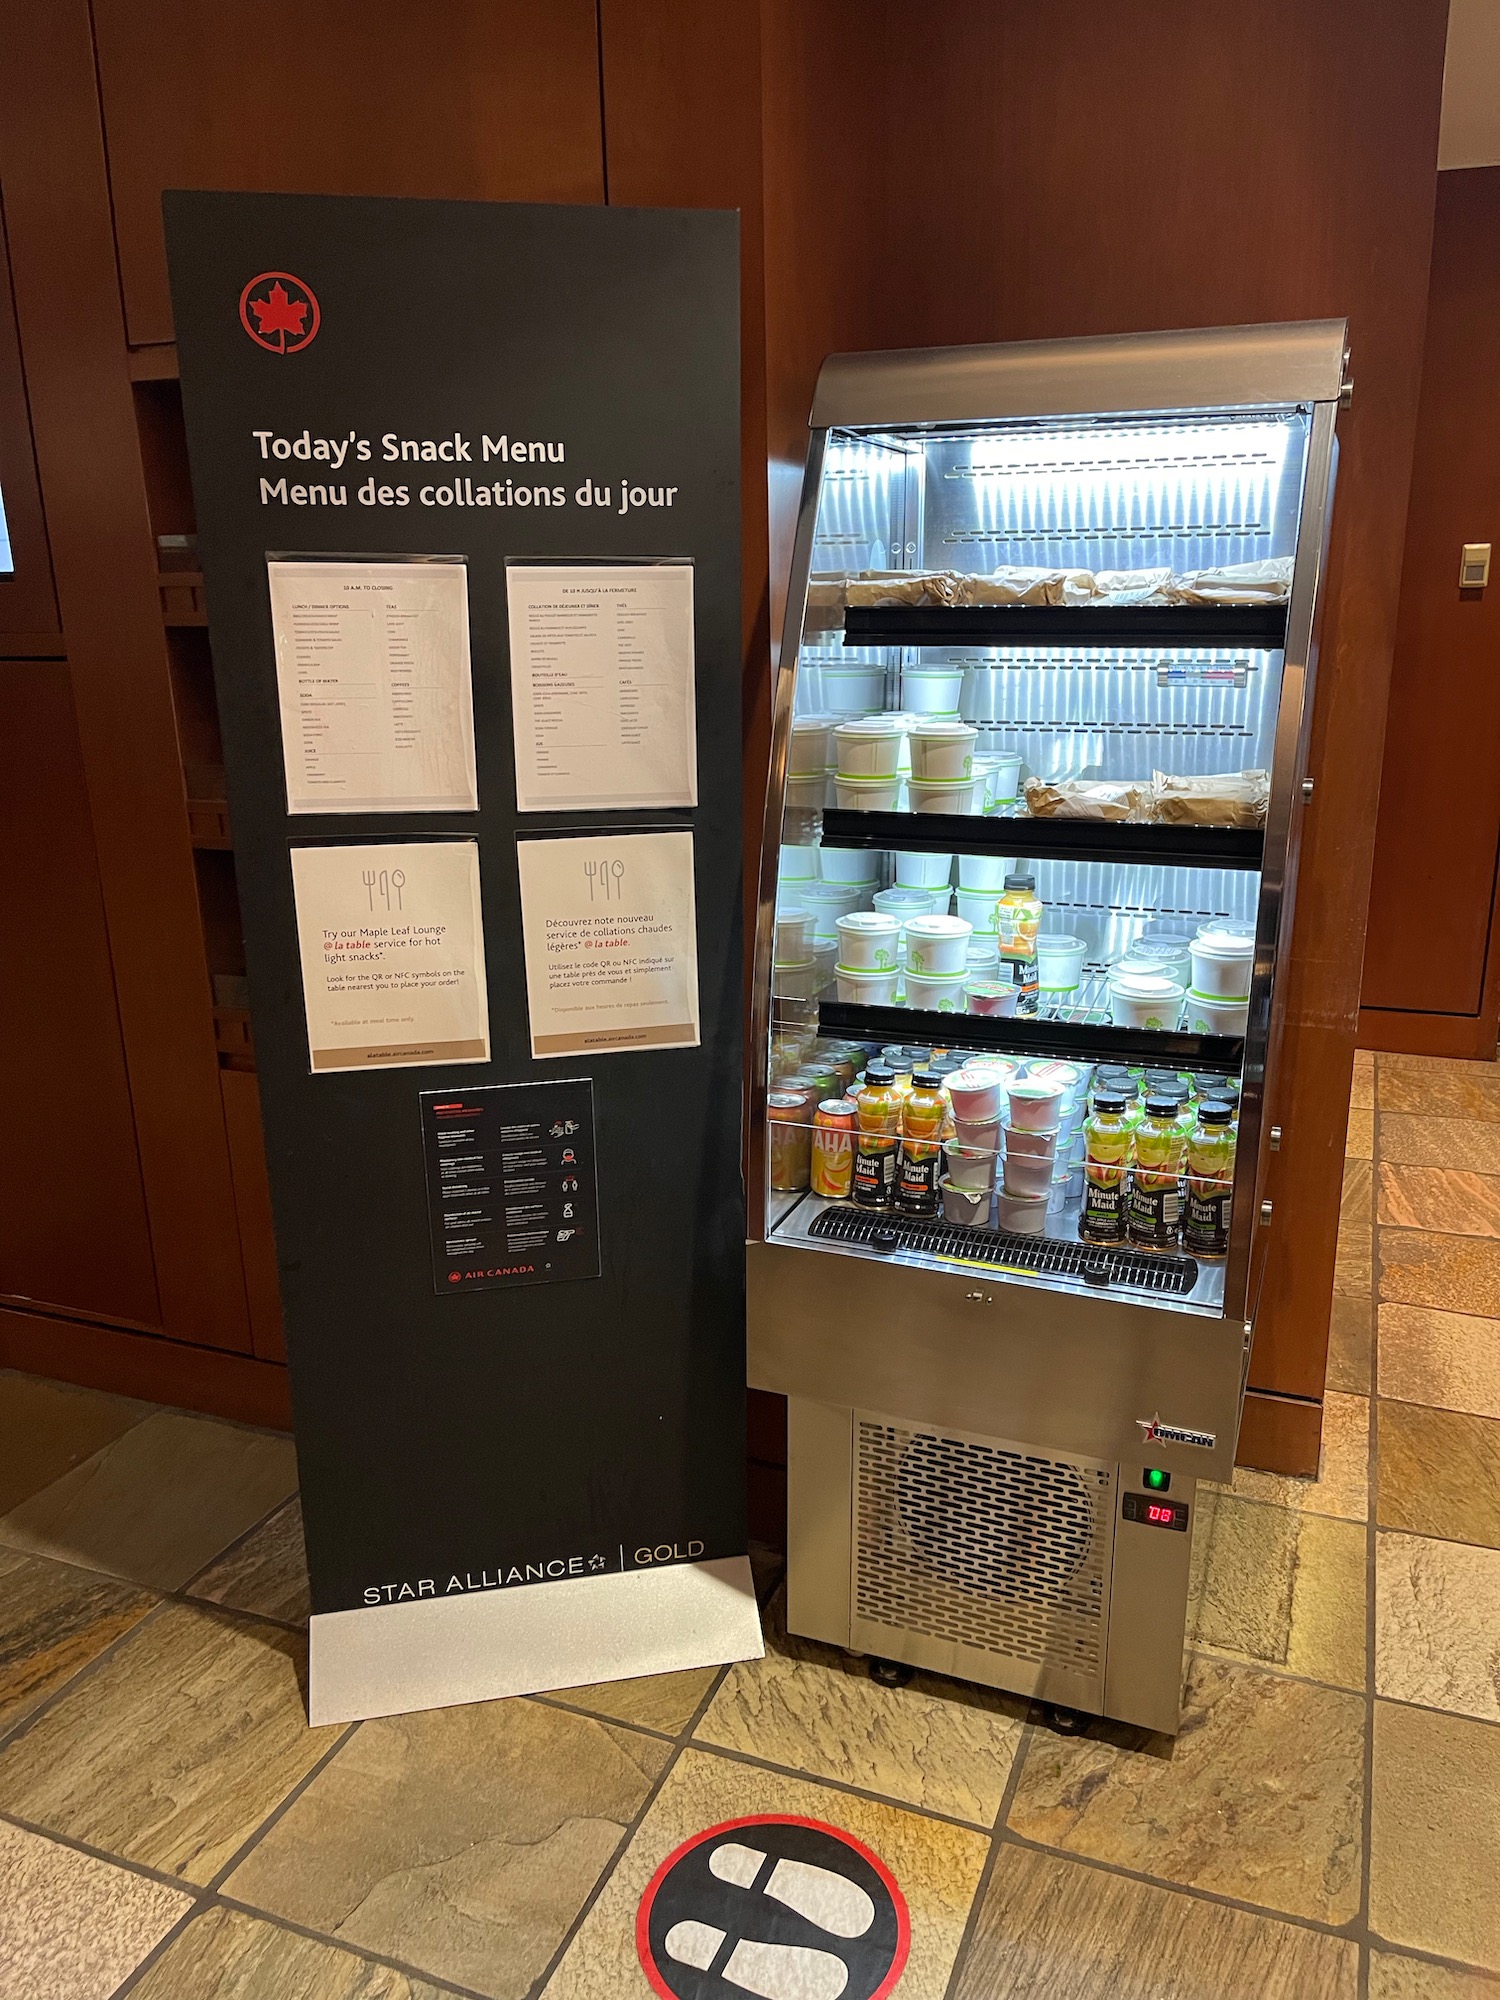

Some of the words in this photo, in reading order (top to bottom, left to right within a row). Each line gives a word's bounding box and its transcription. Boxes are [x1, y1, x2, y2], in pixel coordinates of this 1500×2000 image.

[252, 430, 371, 469] Today's
[381, 433, 472, 463] Snack
[481, 435, 565, 463] Menu
[260, 478, 347, 506] Menu
[357, 478, 410, 506] des
[419, 478, 567, 507] collations
[575, 479, 611, 507] du
[618, 479, 678, 515] jour
[546, 918, 592, 928] Découvrez
[617, 914, 654, 923] nouveau
[322, 930, 338, 940] Try
[360, 928, 388, 938] Maple
[391, 926, 410, 935] Leaf
[413, 925, 446, 936] Lounge
[546, 930, 577, 939] service
[580, 929, 591, 937] de
[593, 926, 635, 936] collations
[638, 924, 672, 933] chaudes
[323, 941, 333, 950] @
[335, 941, 344, 949] la
[346, 940, 371, 949] table
[374, 940, 406, 948] service
[410, 938, 422, 946] for
[425, 937, 441, 945] hot
[584, 941, 593, 949] @
[594, 940, 603, 948] la
[605, 939, 630, 948] table.
[324, 954, 346, 964] light
[549, 962, 573, 971] Utilisez
[600, 960, 611, 968] QR
[639, 956, 663, 966] indiqué
[372, 972, 383, 980] QR
[411, 970, 441, 980] symbols
[582, 970, 597, 979] près
[633, 965, 671, 974] simplement
[400, 980, 419, 990] place
[420, 981, 436, 989] your
[550, 981, 570, 989] placez
[591, 977, 627, 985] commande
[814, 1130, 852, 1152] AHA
[904, 1171, 924, 1182] Maid
[1088, 1188, 1119, 1200] Minute
[1132, 1188, 1158, 1206] Minute
[1091, 1198, 1115, 1210] Maid
[1133, 1199, 1153, 1215] Maid
[1190, 1198, 1216, 1212] Minute
[1191, 1208, 1212, 1222] Maid
[465, 1270, 484, 1279] AIR
[487, 1265, 535, 1277] CANADA
[364, 1580, 435, 1605] STAR
[446, 1556, 584, 1593] ALLIANCE
[634, 1540, 705, 1564] GOLD
